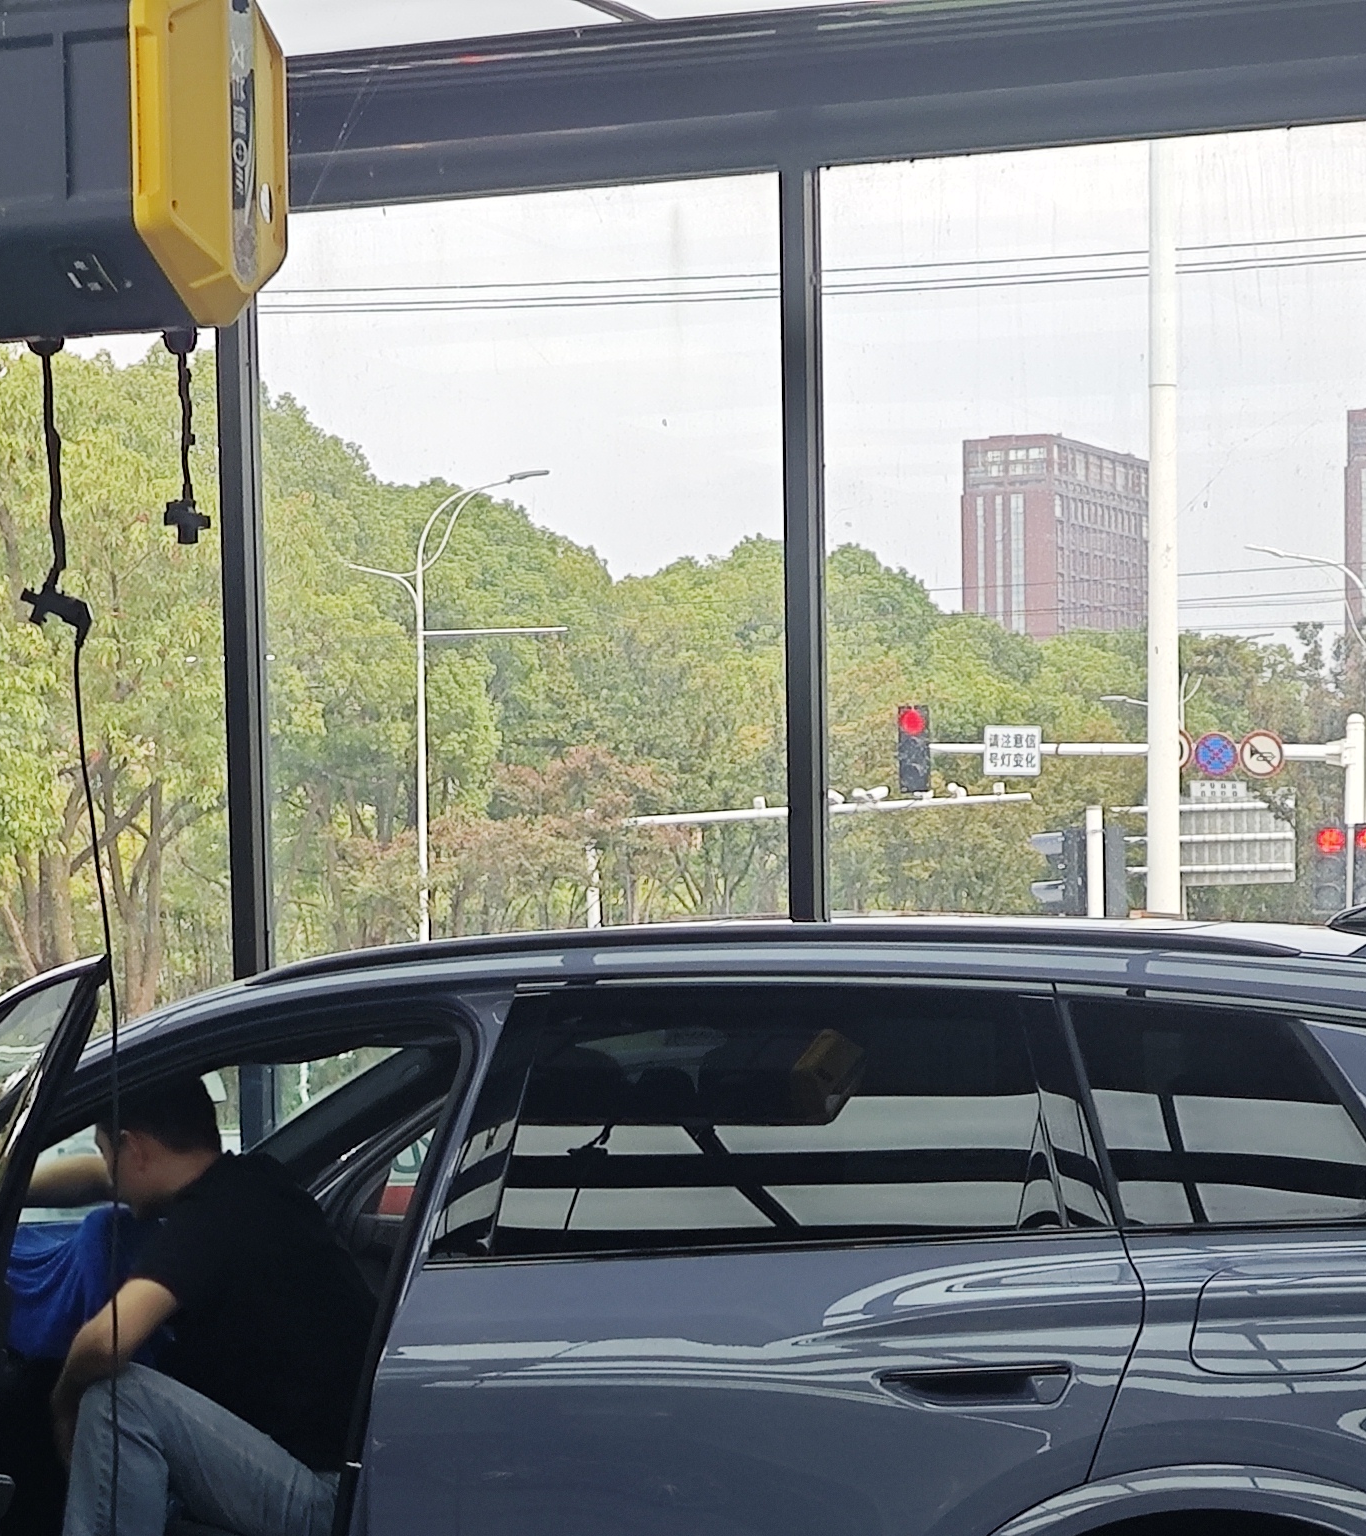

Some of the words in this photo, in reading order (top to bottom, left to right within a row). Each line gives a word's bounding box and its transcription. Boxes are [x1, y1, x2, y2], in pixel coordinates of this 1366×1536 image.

[989, 733, 1036, 749] 请注意信
[989, 752, 1037, 768] 号灯变化
